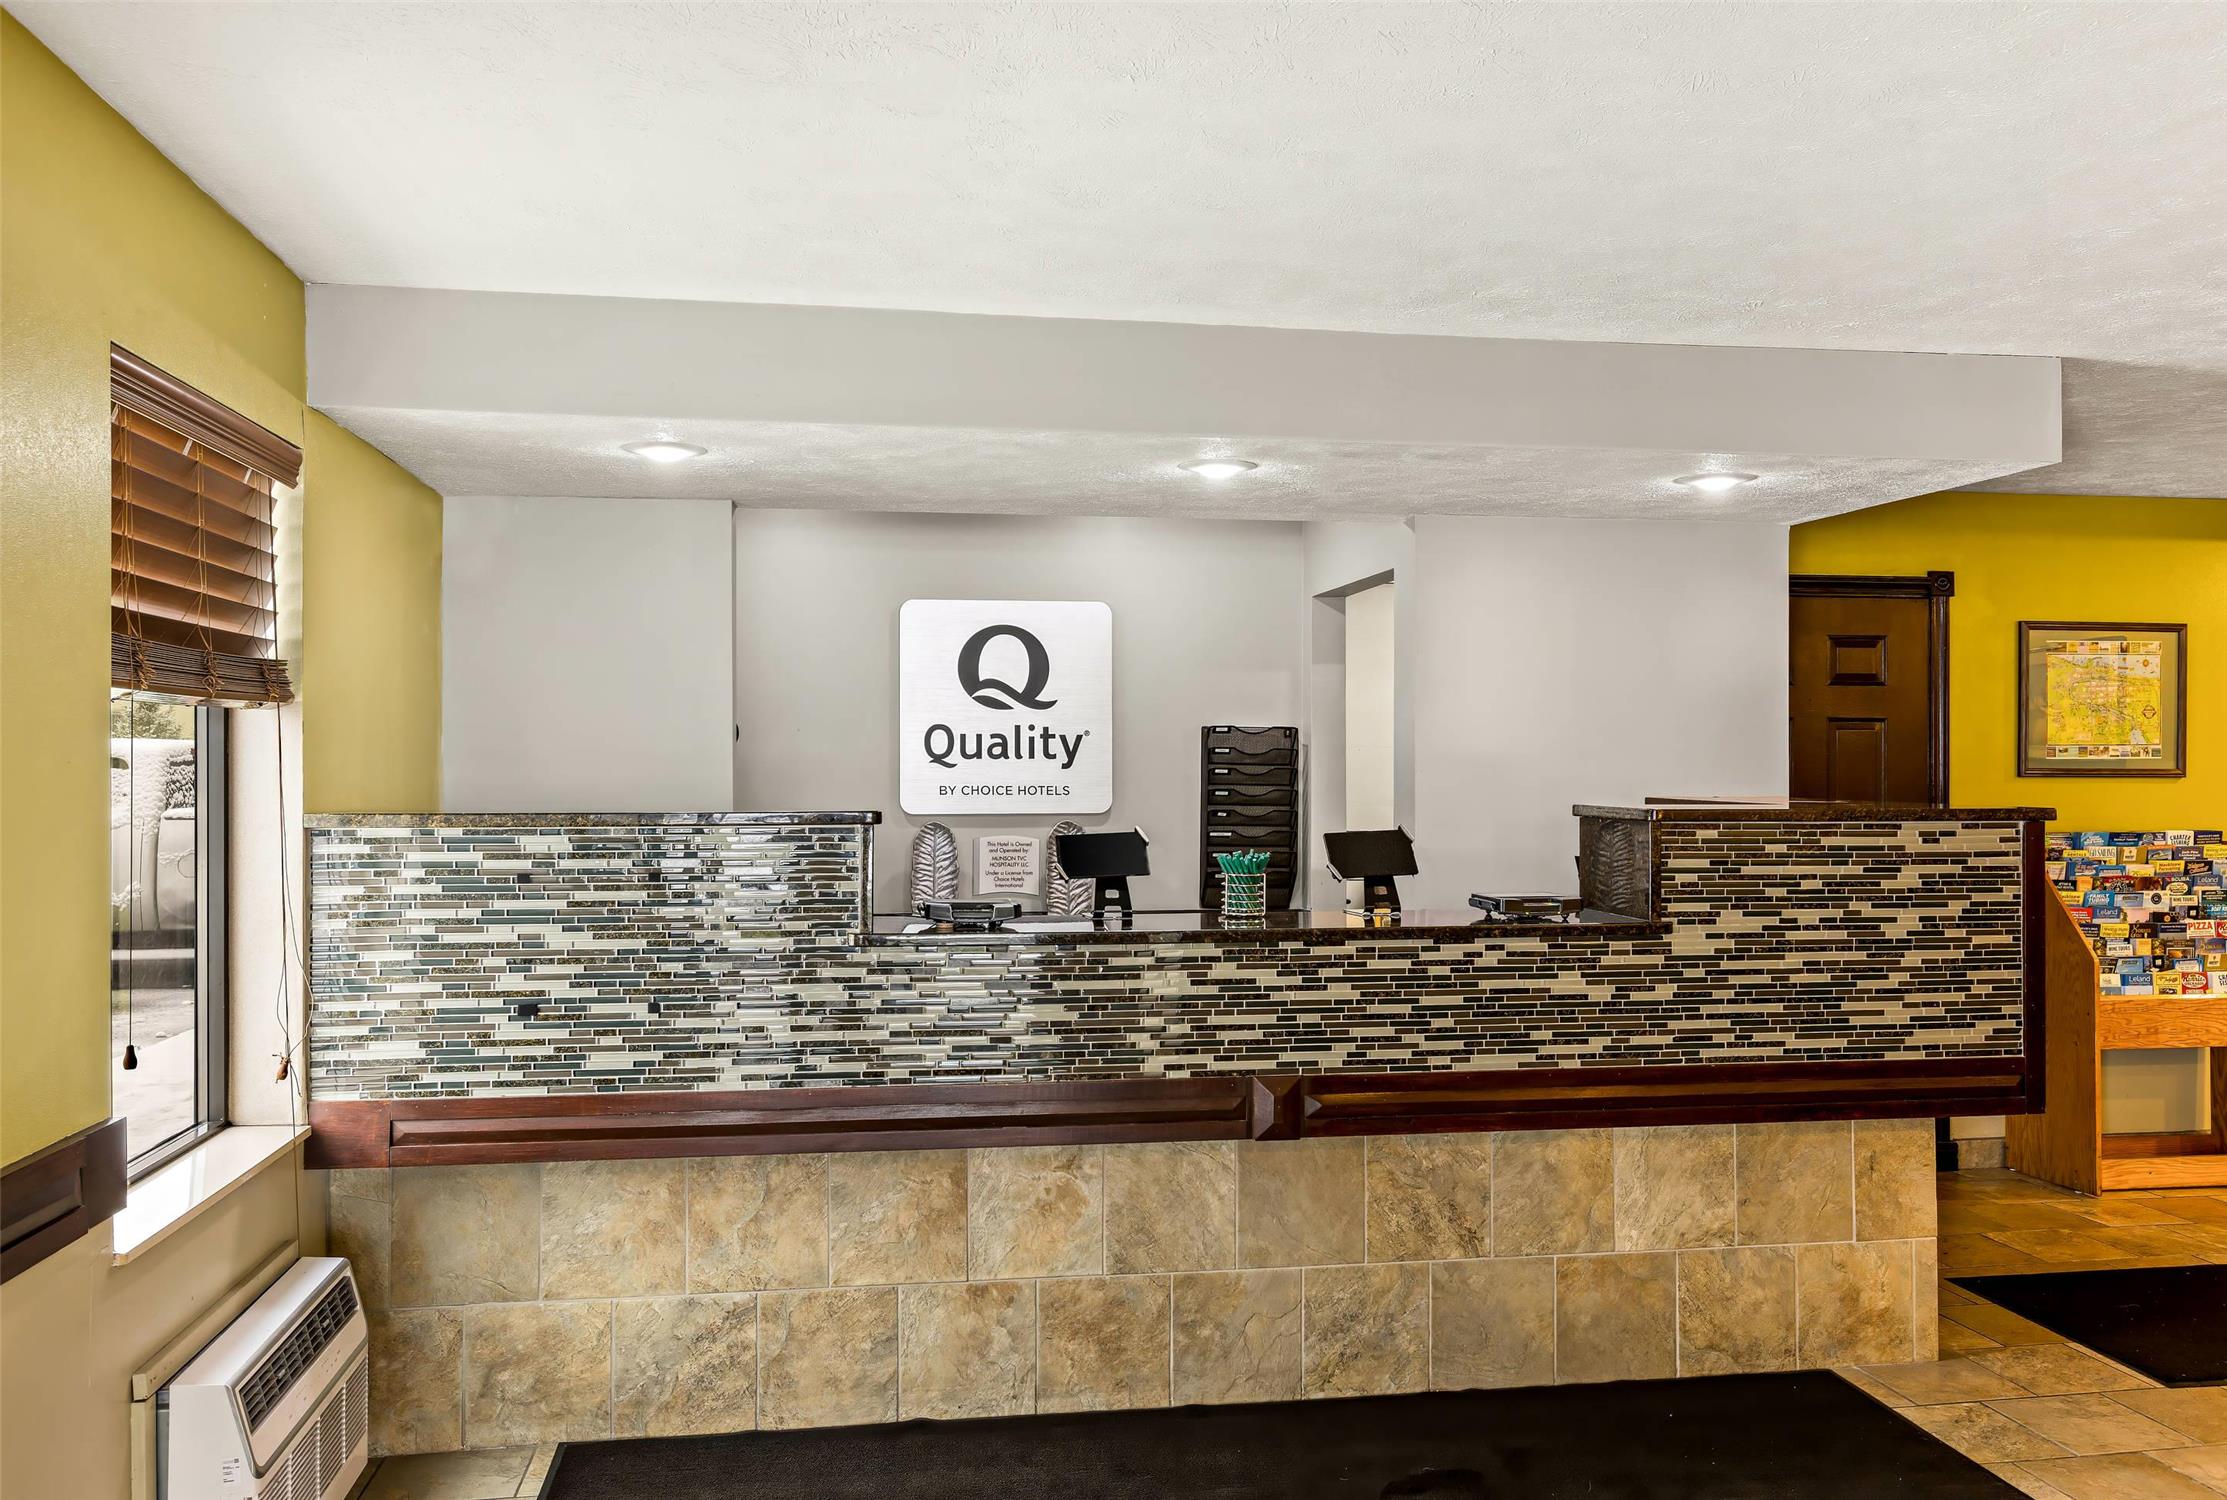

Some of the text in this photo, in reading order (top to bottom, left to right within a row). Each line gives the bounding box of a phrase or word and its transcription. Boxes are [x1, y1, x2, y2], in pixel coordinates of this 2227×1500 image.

[958, 625, 1058, 710] Q
[939, 786, 1070, 795] BY CHOICE HOTELS
[2188, 922, 2213, 930] PIZZA
[2128, 975, 2151, 983] Leland
